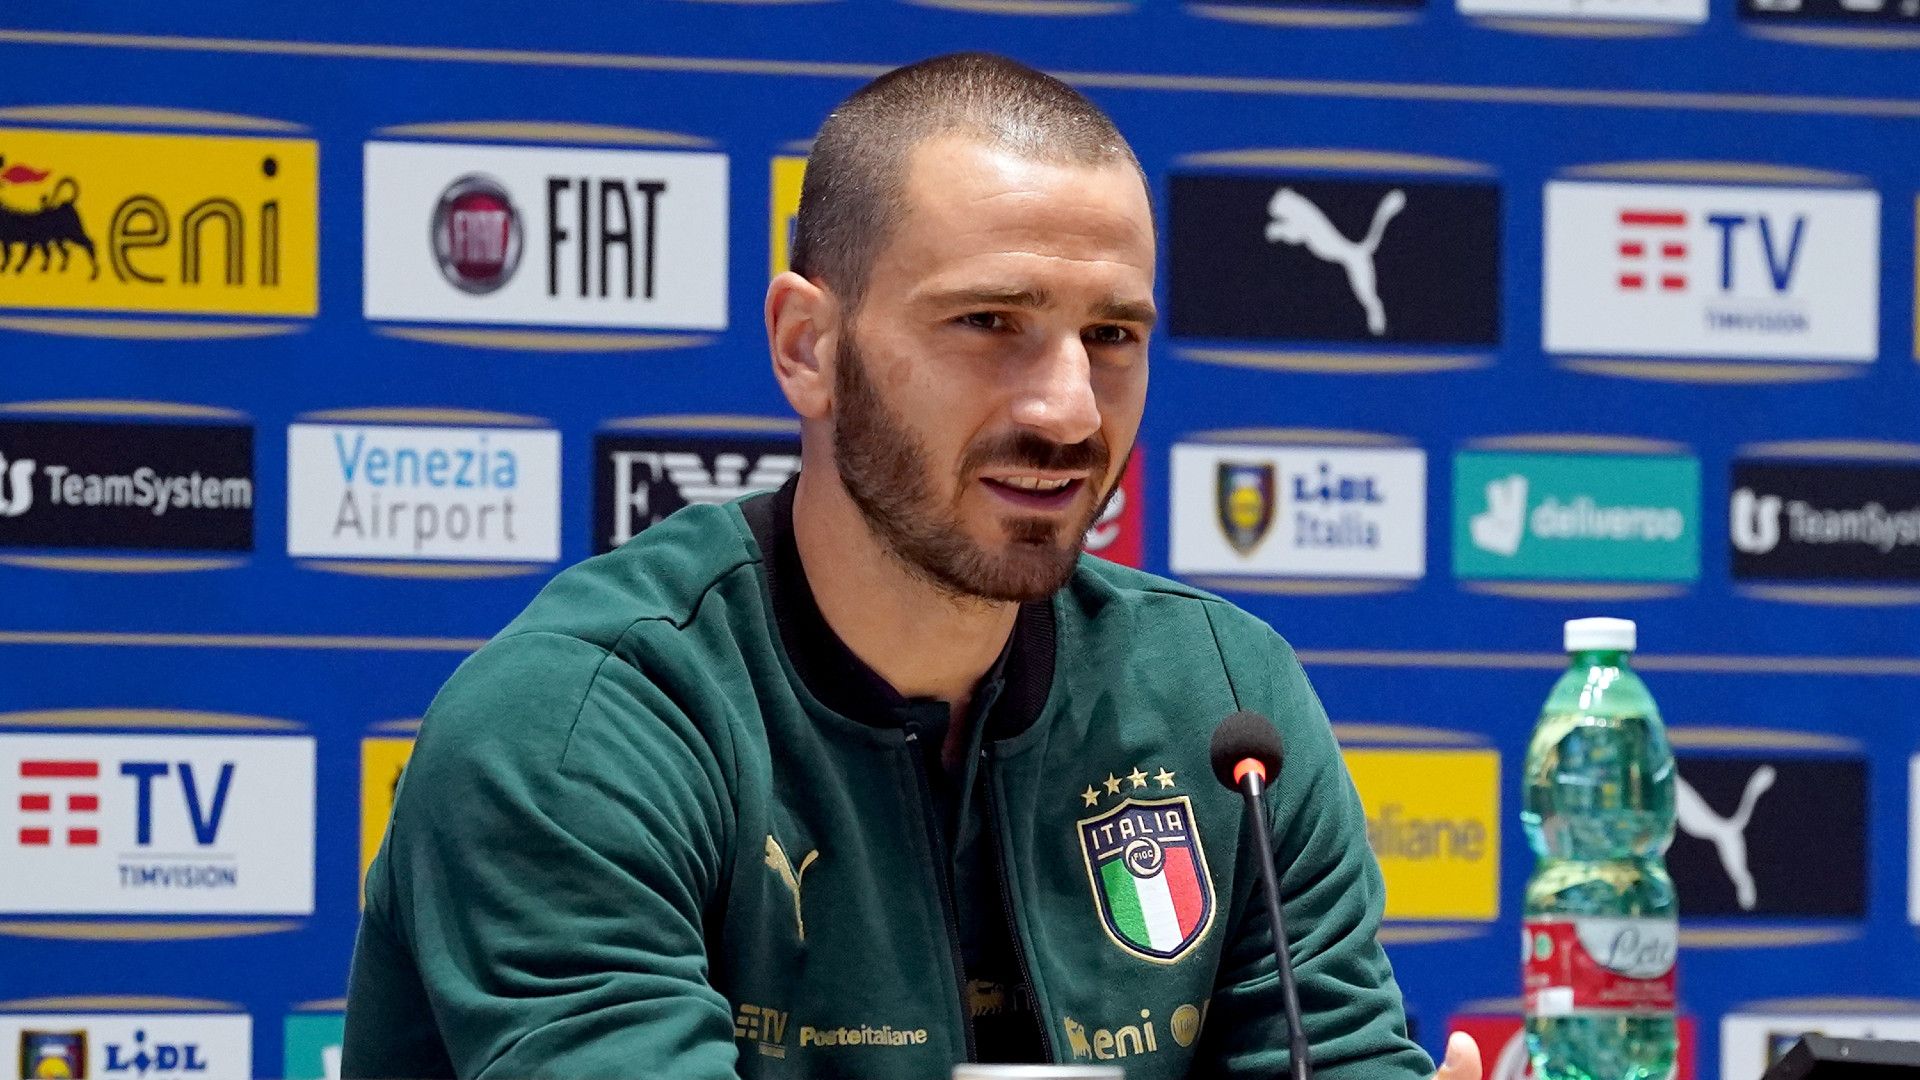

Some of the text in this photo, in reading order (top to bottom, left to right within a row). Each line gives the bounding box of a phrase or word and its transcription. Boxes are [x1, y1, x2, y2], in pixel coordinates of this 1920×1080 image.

[109, 157, 278, 284] eni
[547, 177, 666, 298] FIAT
[1708, 214, 1804, 290] TV
[335, 431, 517, 487] Venezia
[44, 465, 252, 516] TeamSystem
[332, 489, 516, 550] Airport
[1532, 496, 1683, 541] deliveroo
[119, 762, 235, 846] TV
[1091, 811, 1183, 850] ITALIA
[119, 865, 237, 889] TIMVISION
[761, 1008, 788, 1043] TV
[1093, 1008, 1157, 1060] eni
